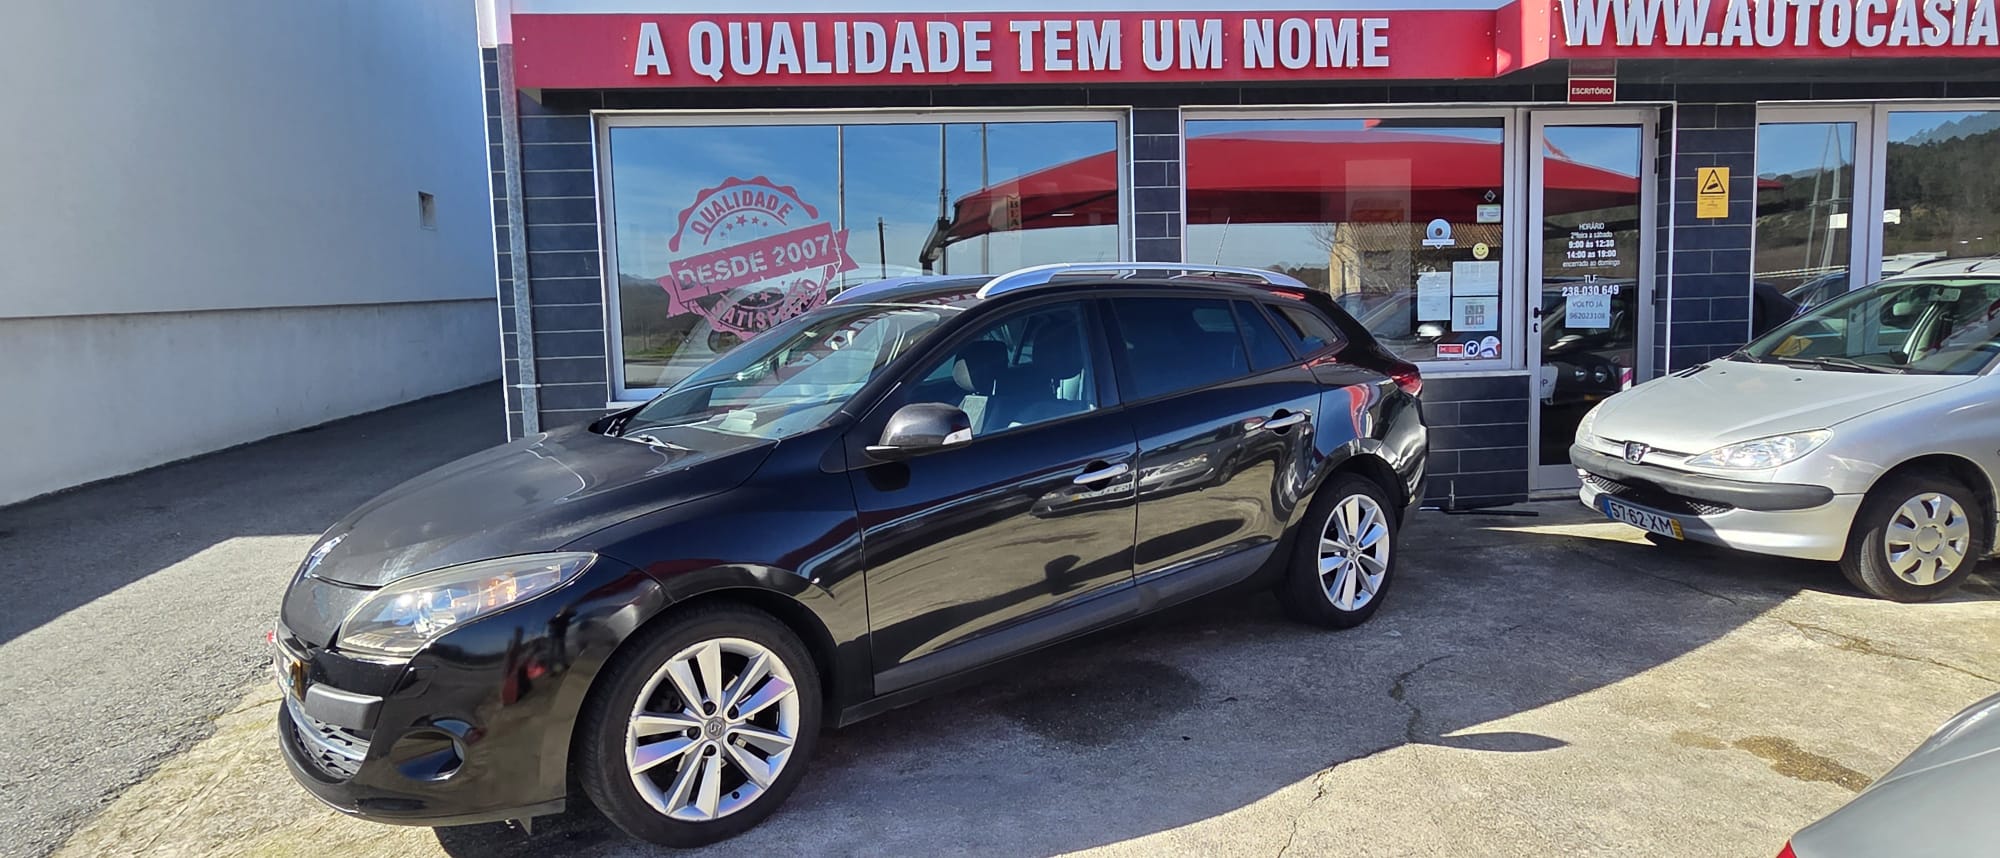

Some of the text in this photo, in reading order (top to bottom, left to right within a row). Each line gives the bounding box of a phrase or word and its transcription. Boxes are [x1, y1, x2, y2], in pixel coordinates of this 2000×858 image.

[634, 18, 1389, 82] A QUALIDADE TEM UM NOME
[1571, 86, 1612, 95] ESCRITÓRIO
[691, 190, 793, 235] QUALIDADE
[1579, 222, 1604, 230] HORÁRIO
[1569, 241, 1584, 249] 9:00
[1596, 239, 1615, 248] 12:30
[1566, 250, 1586, 259] 14:00
[677, 234, 830, 291] DESDE 2007
[1572, 300, 1595, 308] VOLTO
